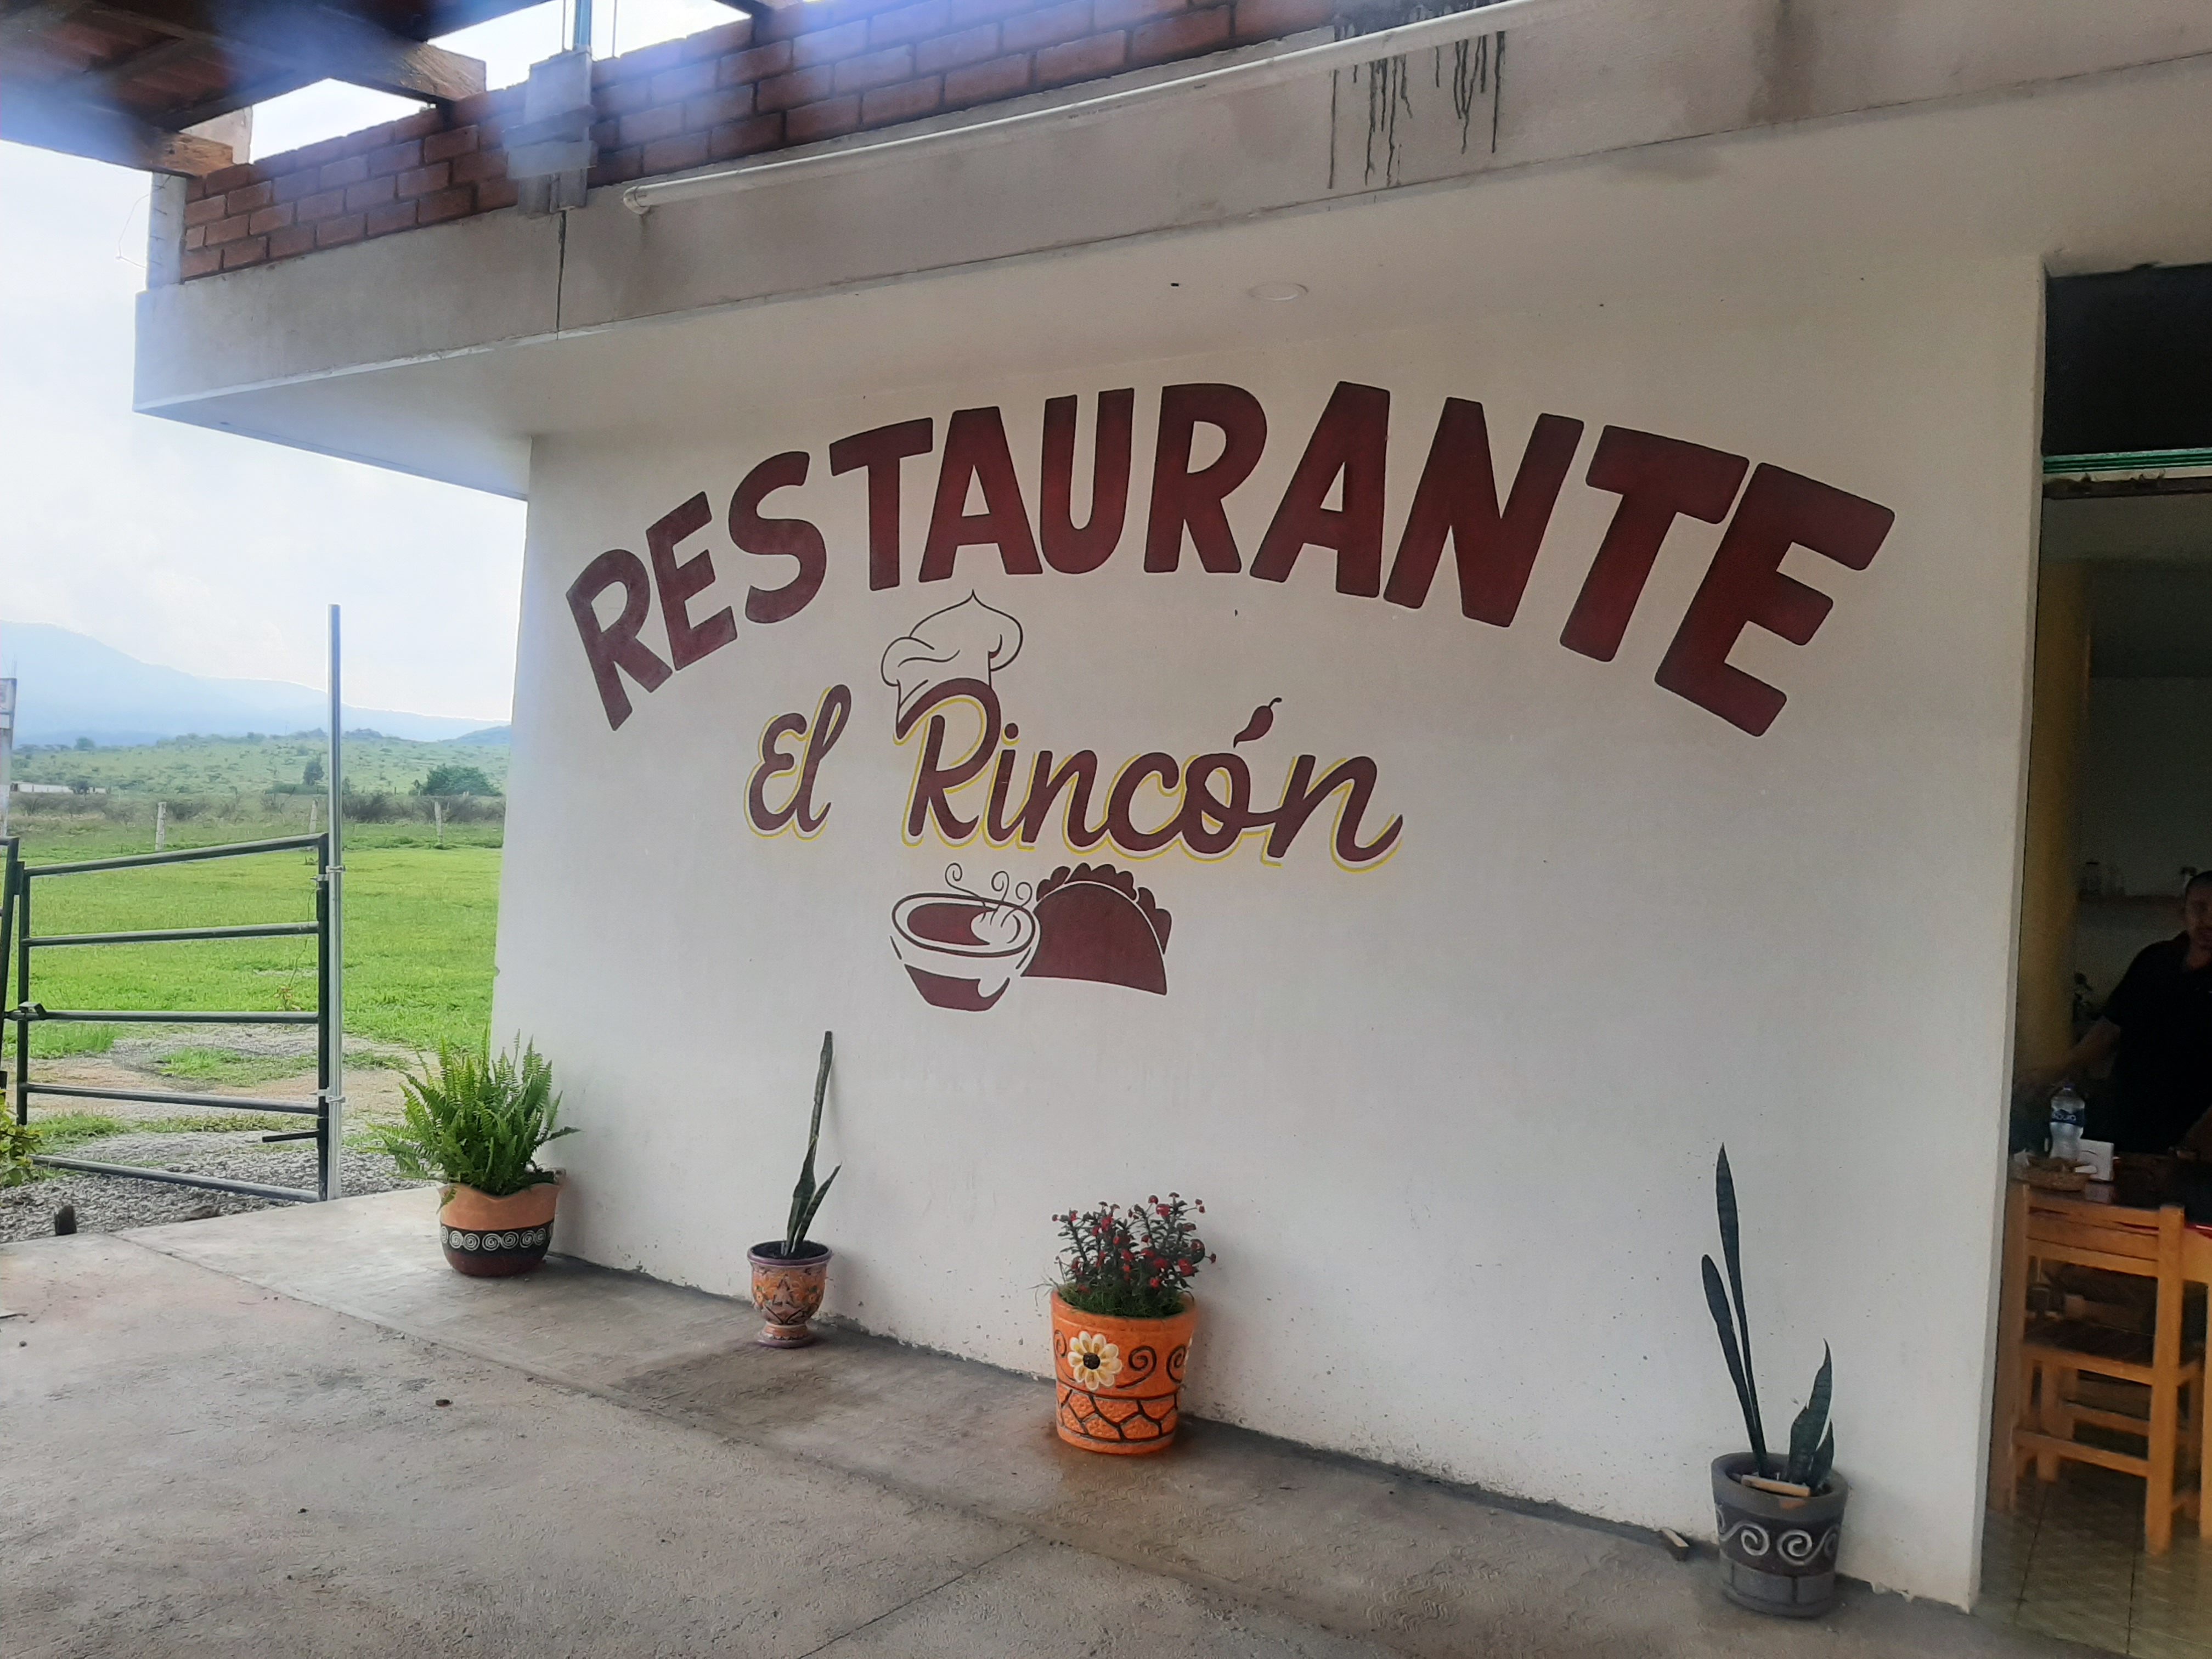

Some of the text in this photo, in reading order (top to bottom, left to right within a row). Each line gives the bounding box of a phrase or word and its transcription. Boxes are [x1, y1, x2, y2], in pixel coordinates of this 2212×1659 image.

[567, 380, 1896, 738] RESTAURANTE
[747, 679, 1404, 865] El Rincón
